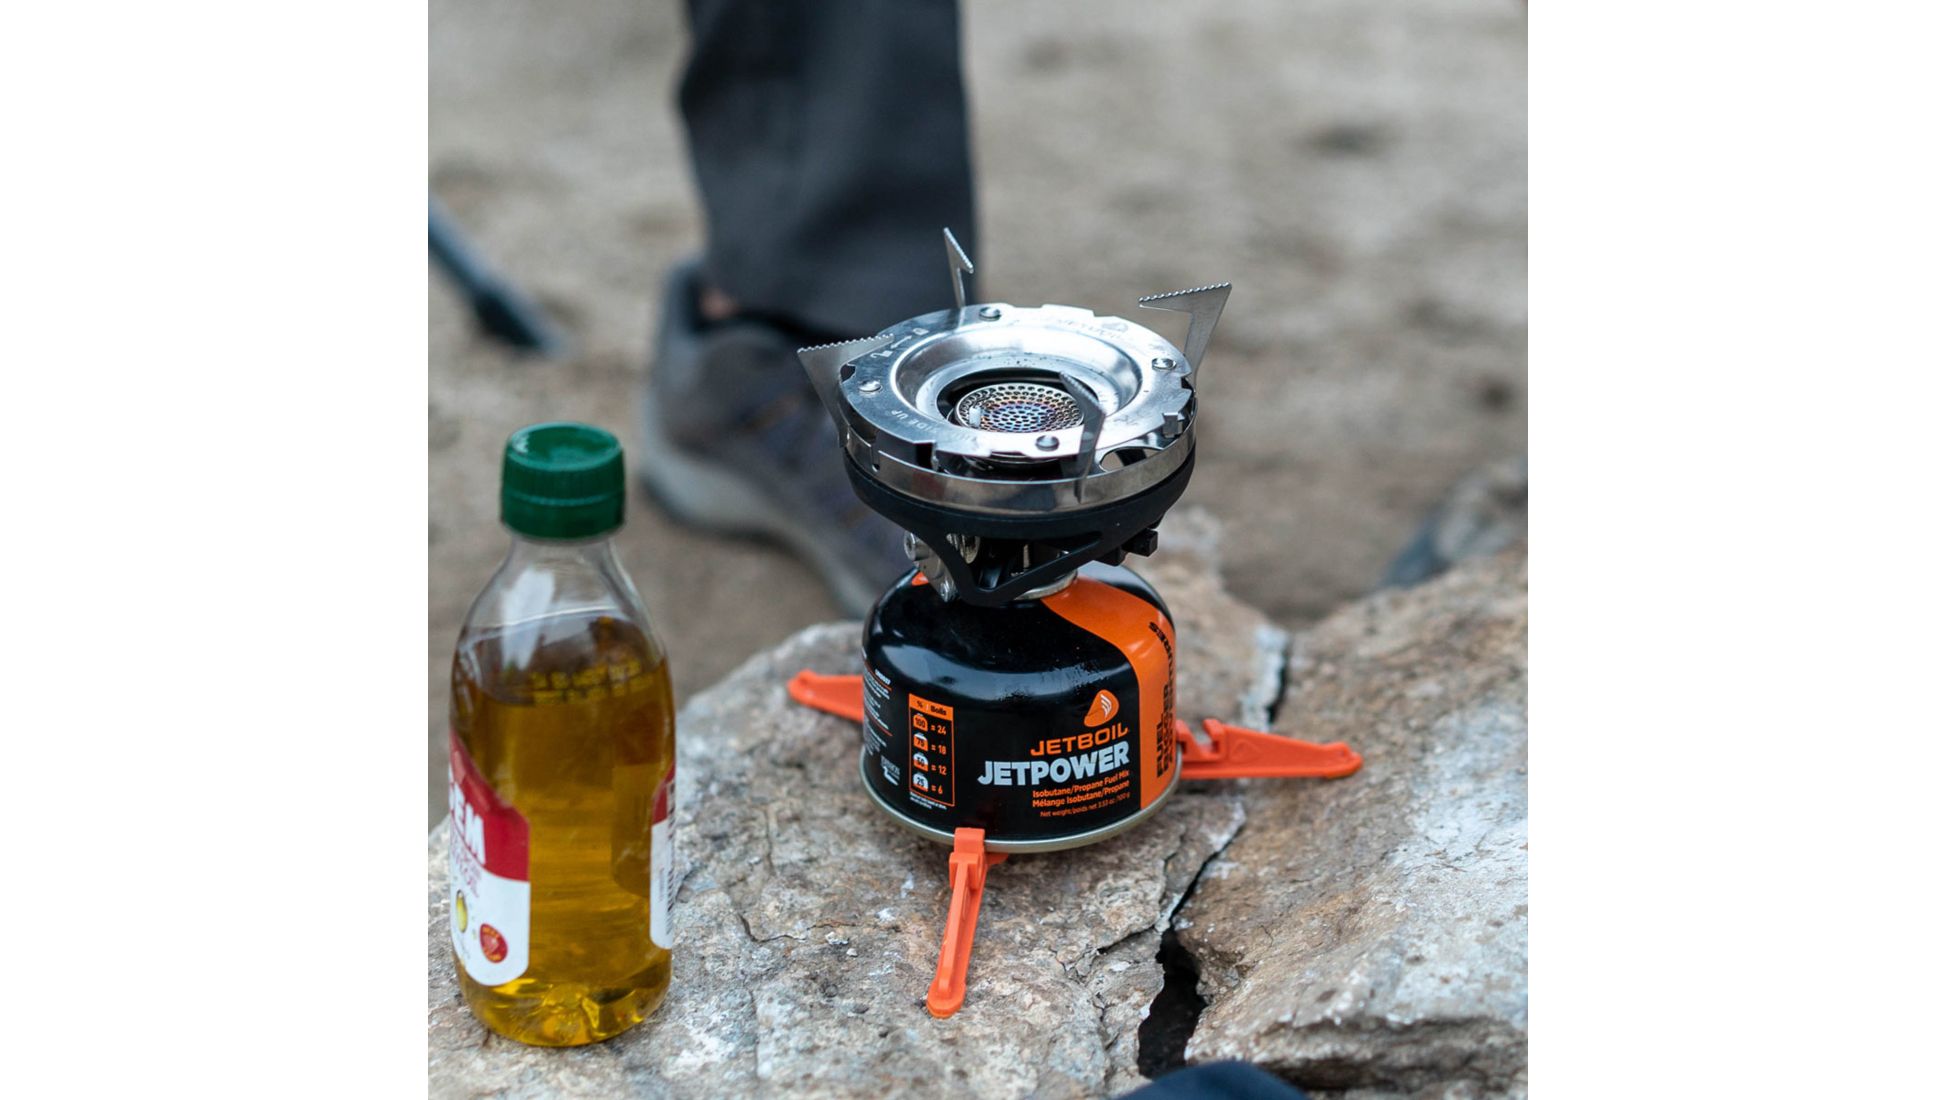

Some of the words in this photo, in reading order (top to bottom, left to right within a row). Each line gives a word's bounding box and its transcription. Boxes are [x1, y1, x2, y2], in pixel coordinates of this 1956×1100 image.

[914, 716, 926, 727] 100
[937, 725, 947, 735] 24
[916, 738, 925, 748] 75
[938, 744, 947, 755] 18
[1030, 722, 1129, 757] JETBOIL
[1156, 713, 1164, 778] FUEL
[938, 765, 947, 776] 12
[977, 740, 1130, 786] JETPOWER
[916, 775, 925, 786] 25
[937, 784, 943, 795] 6
[1032, 779, 1103, 798] Isobutane/Propane
[1104, 773, 1119, 785] Fuel
[1119, 769, 1130, 779] Mix
[1032, 797, 1066, 808] Mélange
[1066, 780, 1130, 804] Isobutane/Propane
[1040, 810, 1051, 818] Net
